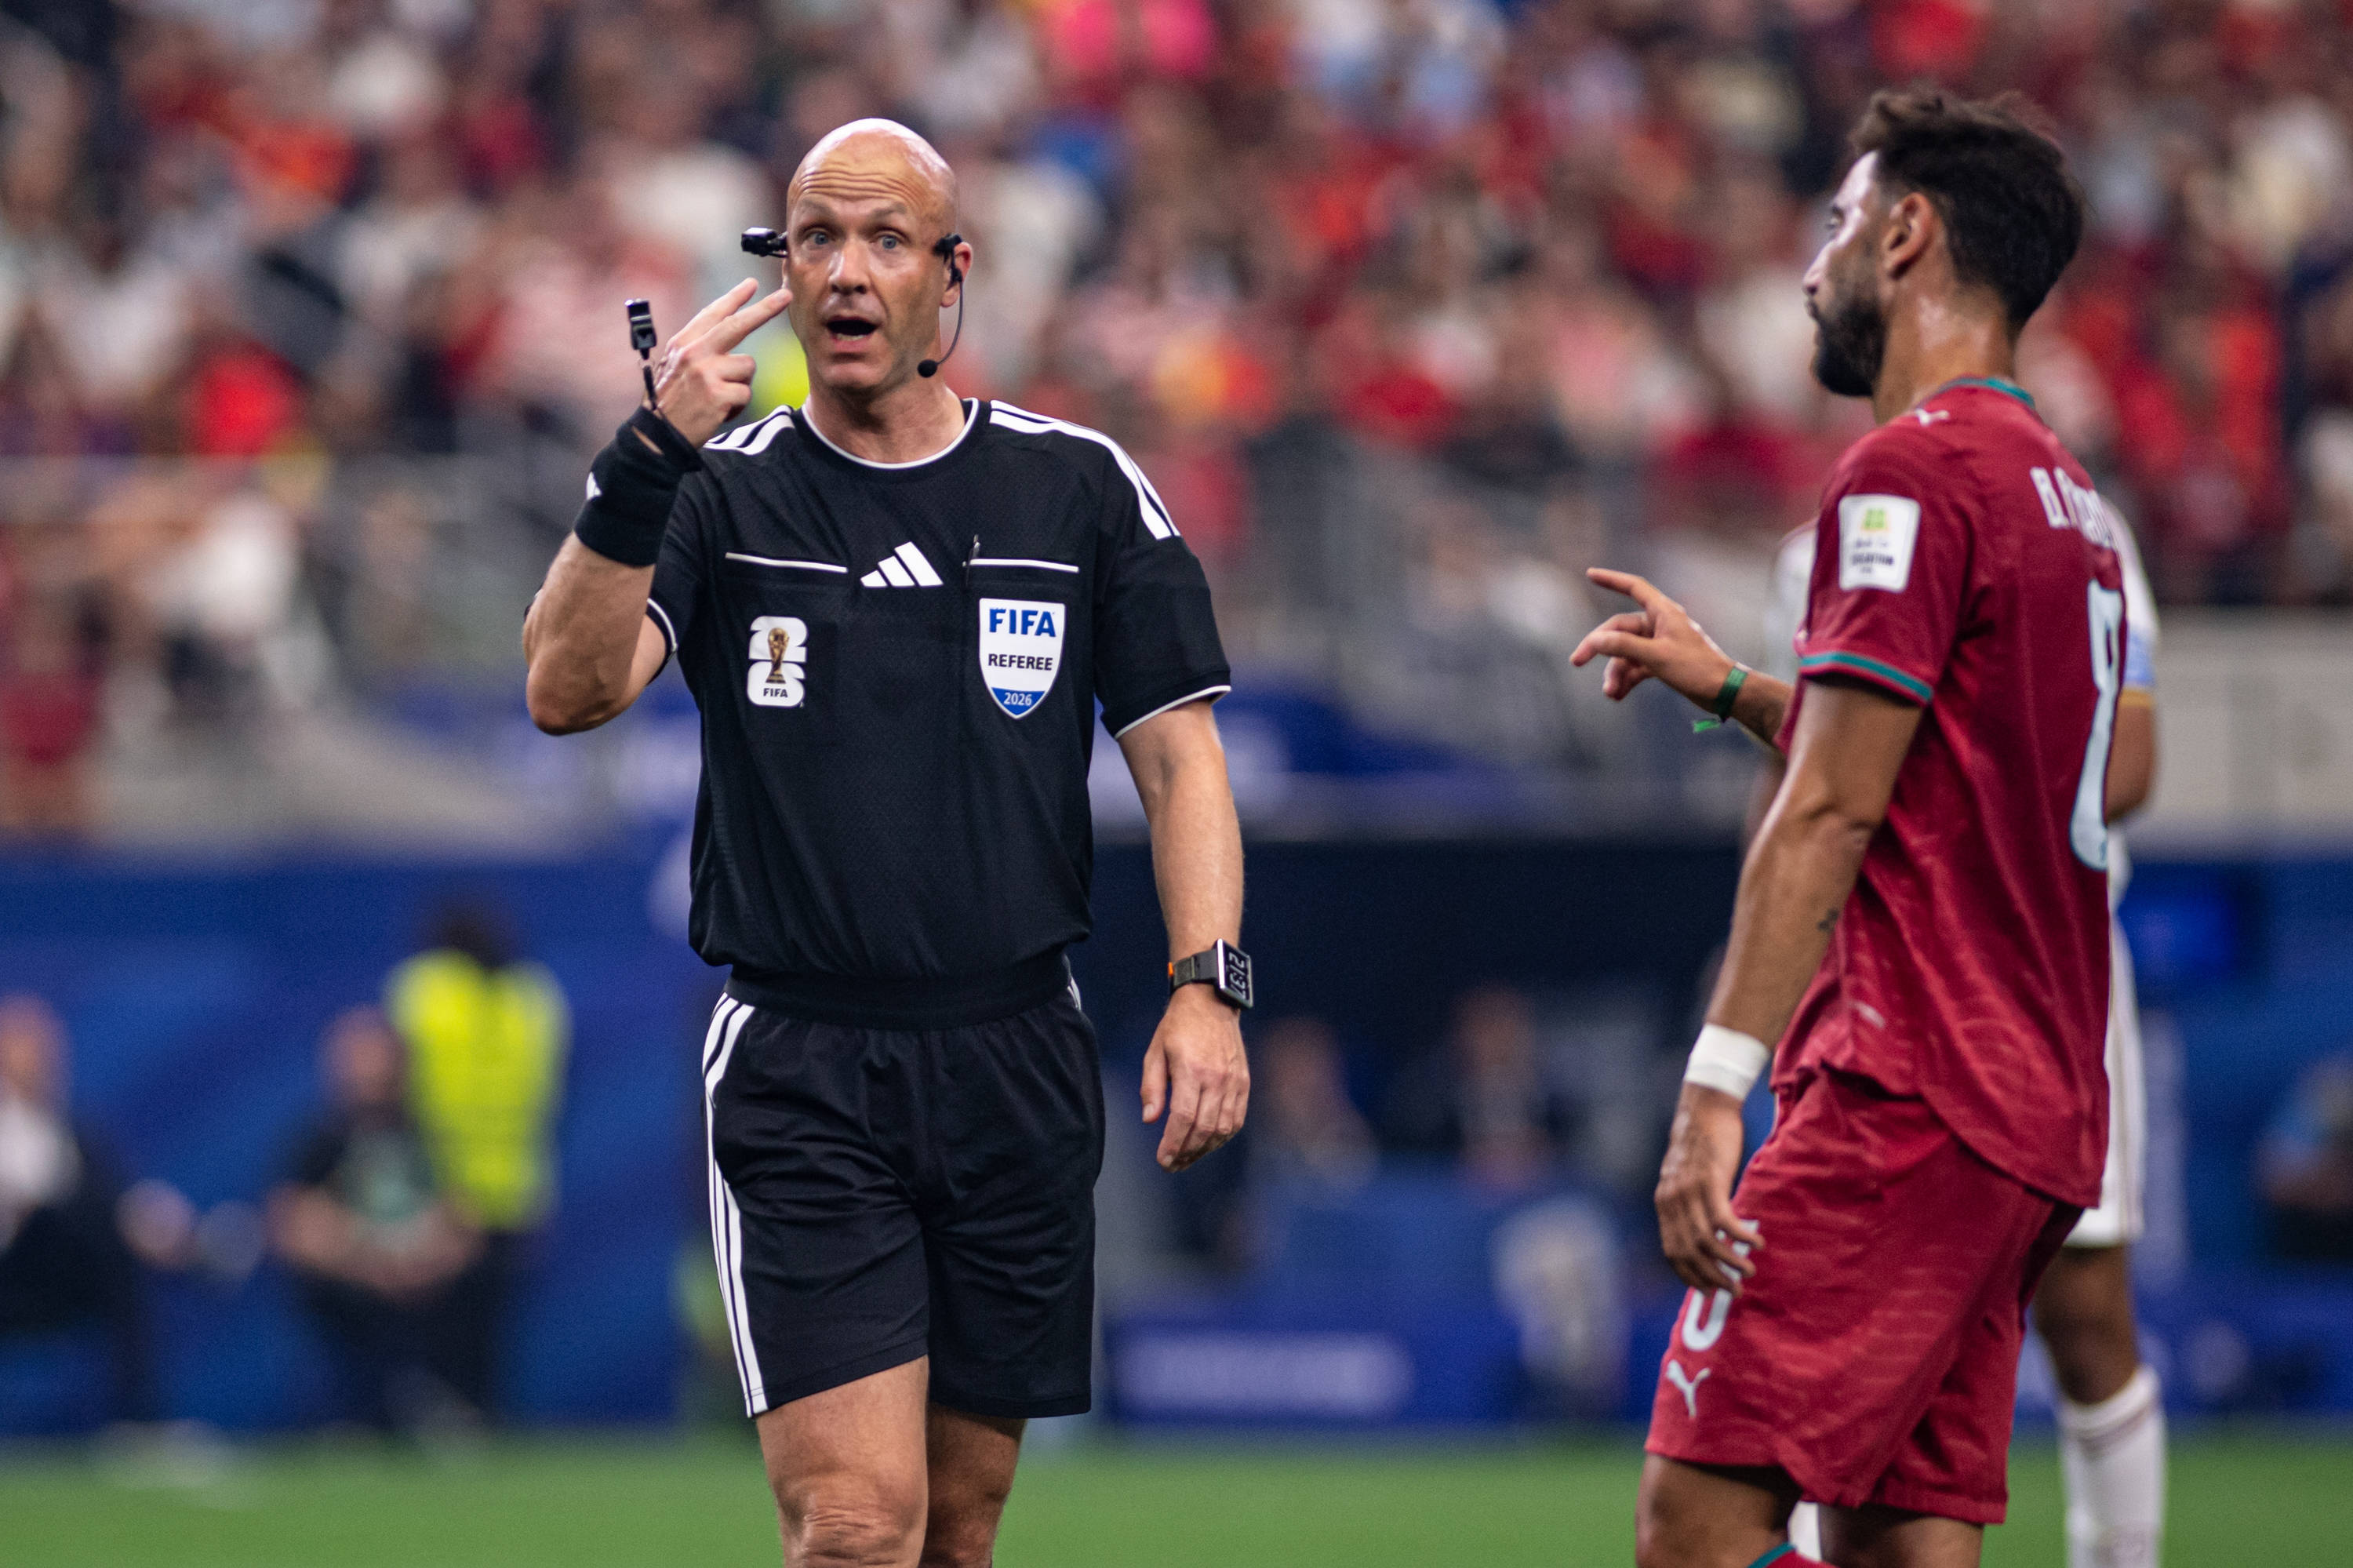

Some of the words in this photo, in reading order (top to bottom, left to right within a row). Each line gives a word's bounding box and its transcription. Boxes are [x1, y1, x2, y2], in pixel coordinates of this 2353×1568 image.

[989, 609, 1056, 637] FIFA
[988, 653, 1053, 671] REFEREE
[763, 688, 788, 698] FIFA
[1004, 692, 1032, 706] 2026
